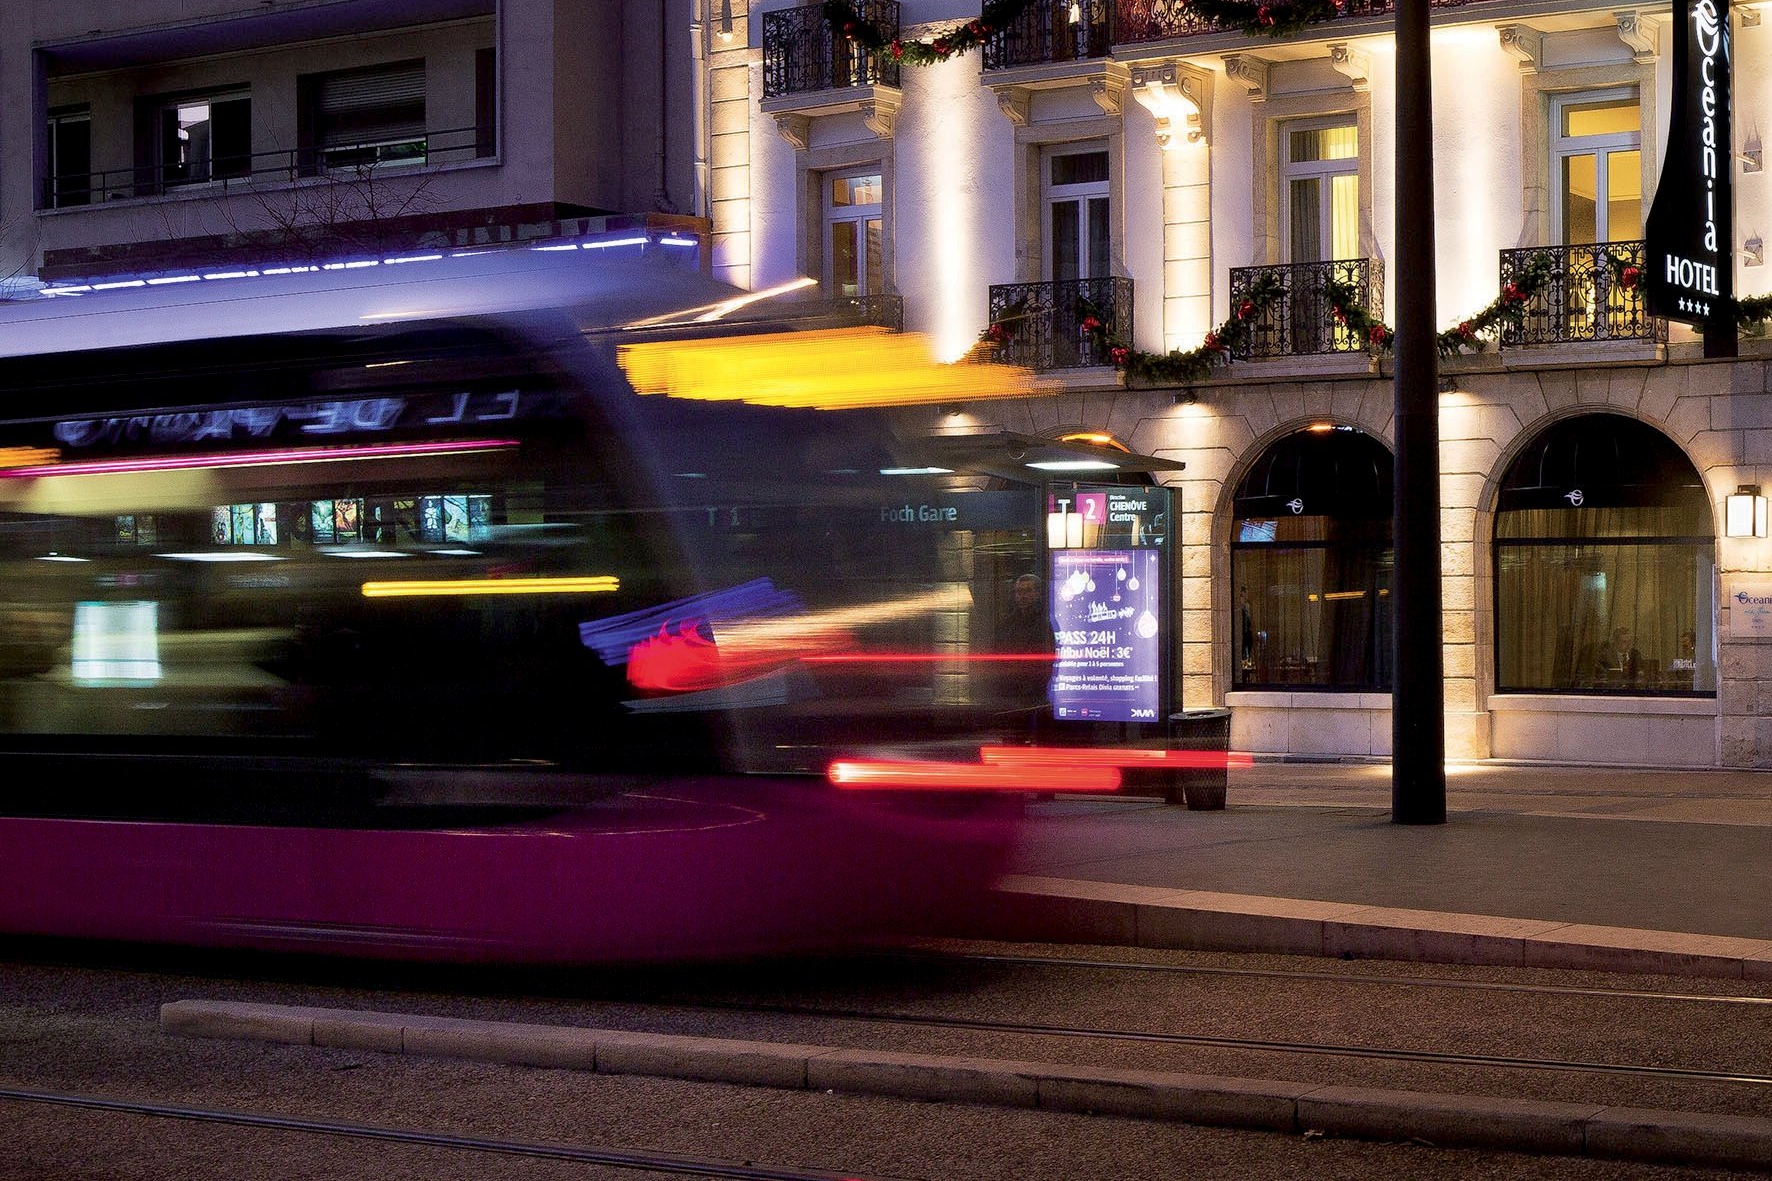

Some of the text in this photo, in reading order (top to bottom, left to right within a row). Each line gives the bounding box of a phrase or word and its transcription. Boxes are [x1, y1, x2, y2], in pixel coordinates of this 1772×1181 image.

[1666, 254, 1719, 296] HOTEL
[1085, 498, 1096, 519] 2
[1110, 500, 1147, 511] CHENÔVE
[919, 505, 957, 522] Gare
[1110, 512, 1136, 522] Centre
[1059, 630, 1116, 645] PASS 24H
[1085, 647, 1110, 658] Noël
[1110, 675, 1134, 683] shopping
